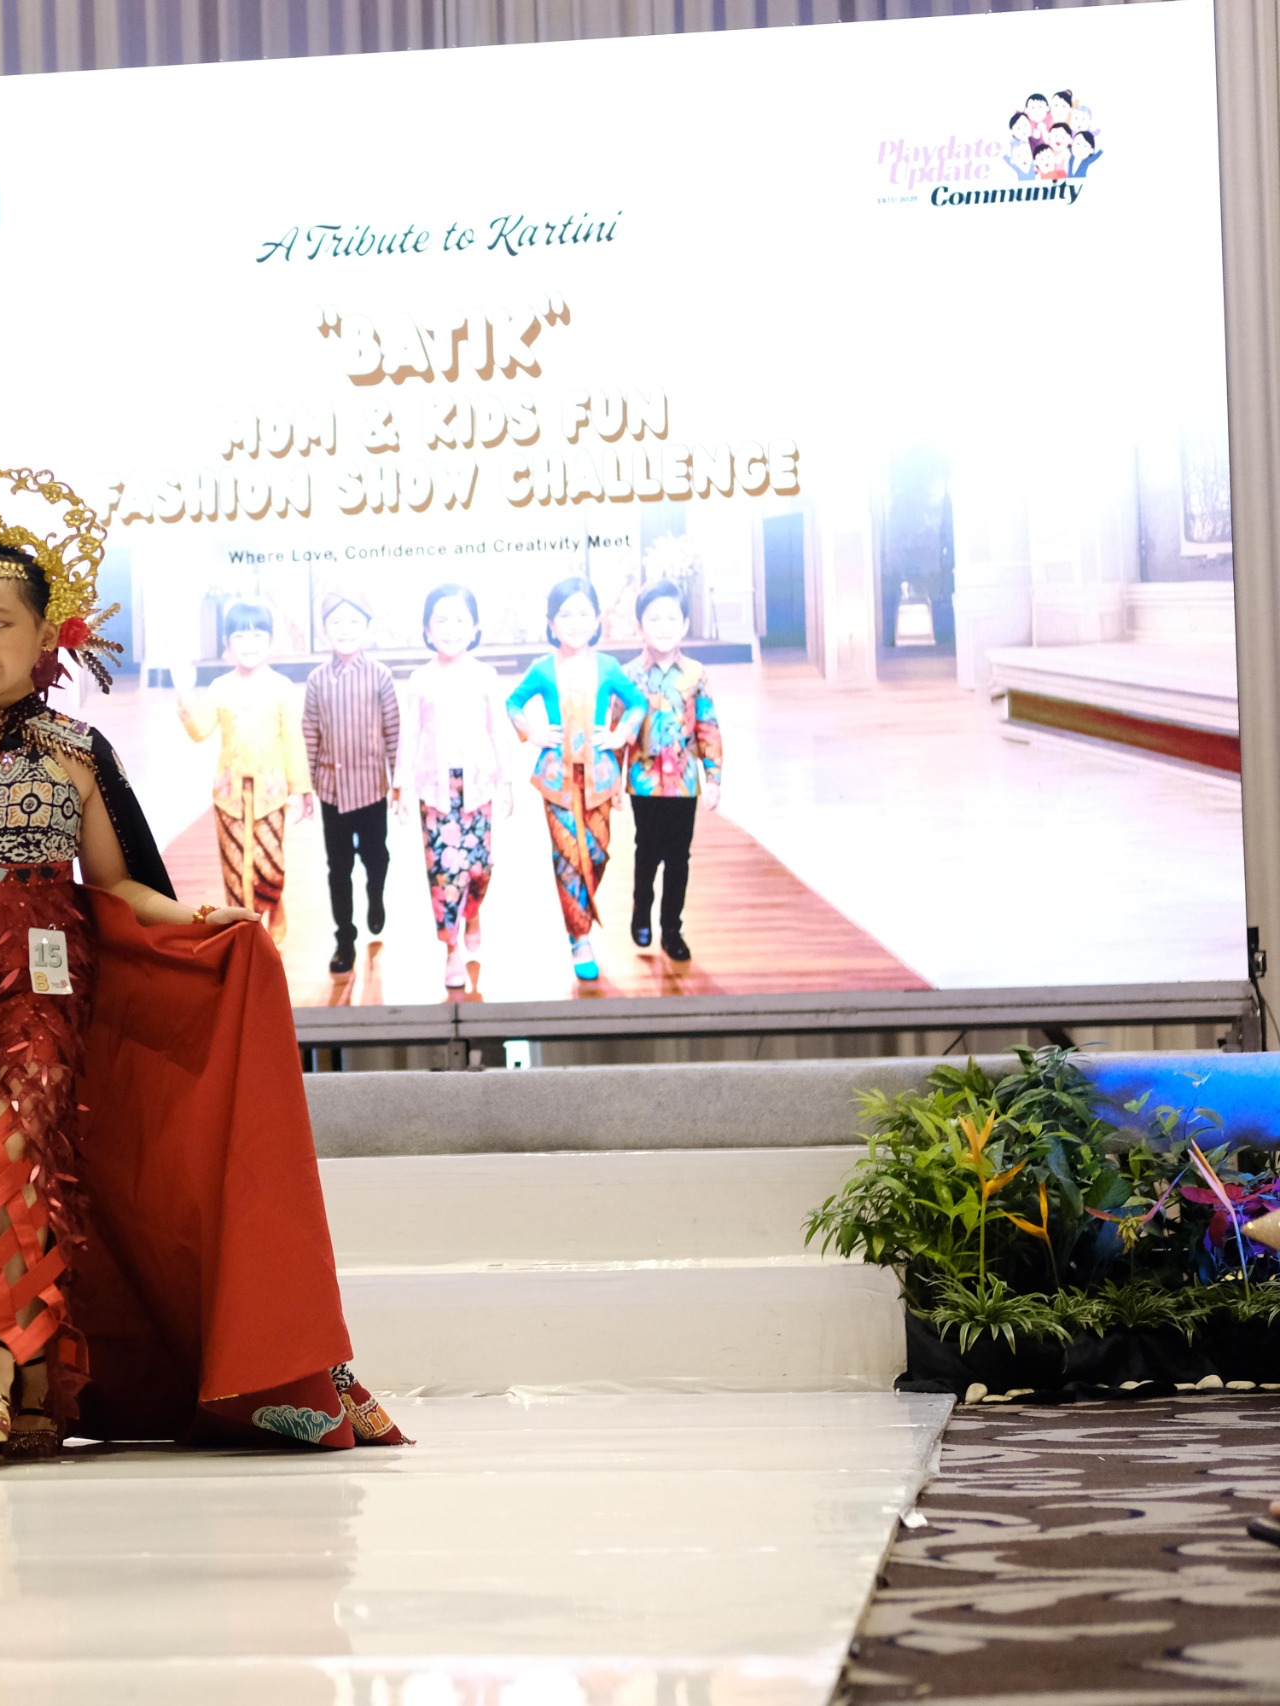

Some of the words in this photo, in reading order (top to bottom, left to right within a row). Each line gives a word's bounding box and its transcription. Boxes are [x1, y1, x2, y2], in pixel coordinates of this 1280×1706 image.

[877, 136, 1002, 168] Playdate
[890, 157, 991, 190] Update
[930, 178, 1083, 206] Community
[256, 226, 300, 262] A
[306, 223, 430, 260] Tribute
[443, 220, 474, 252] to
[487, 211, 622, 257] Kartini
[218, 404, 337, 461] MOM
[359, 397, 401, 454] &
[424, 392, 543, 450] KIDS
[561, 385, 671, 443] FUN
[93, 462, 312, 527] FASHION
[334, 454, 479, 516] SHOW
[497, 438, 801, 506] CHALLENGE
[229, 550, 284, 565] Where
[292, 549, 337, 563] Love,
[345, 543, 447, 560] Confidence
[455, 541, 486, 555] and
[493, 536, 581, 553] Creativity
[587, 534, 631, 549] Meet
[34, 943, 63, 968] 15
